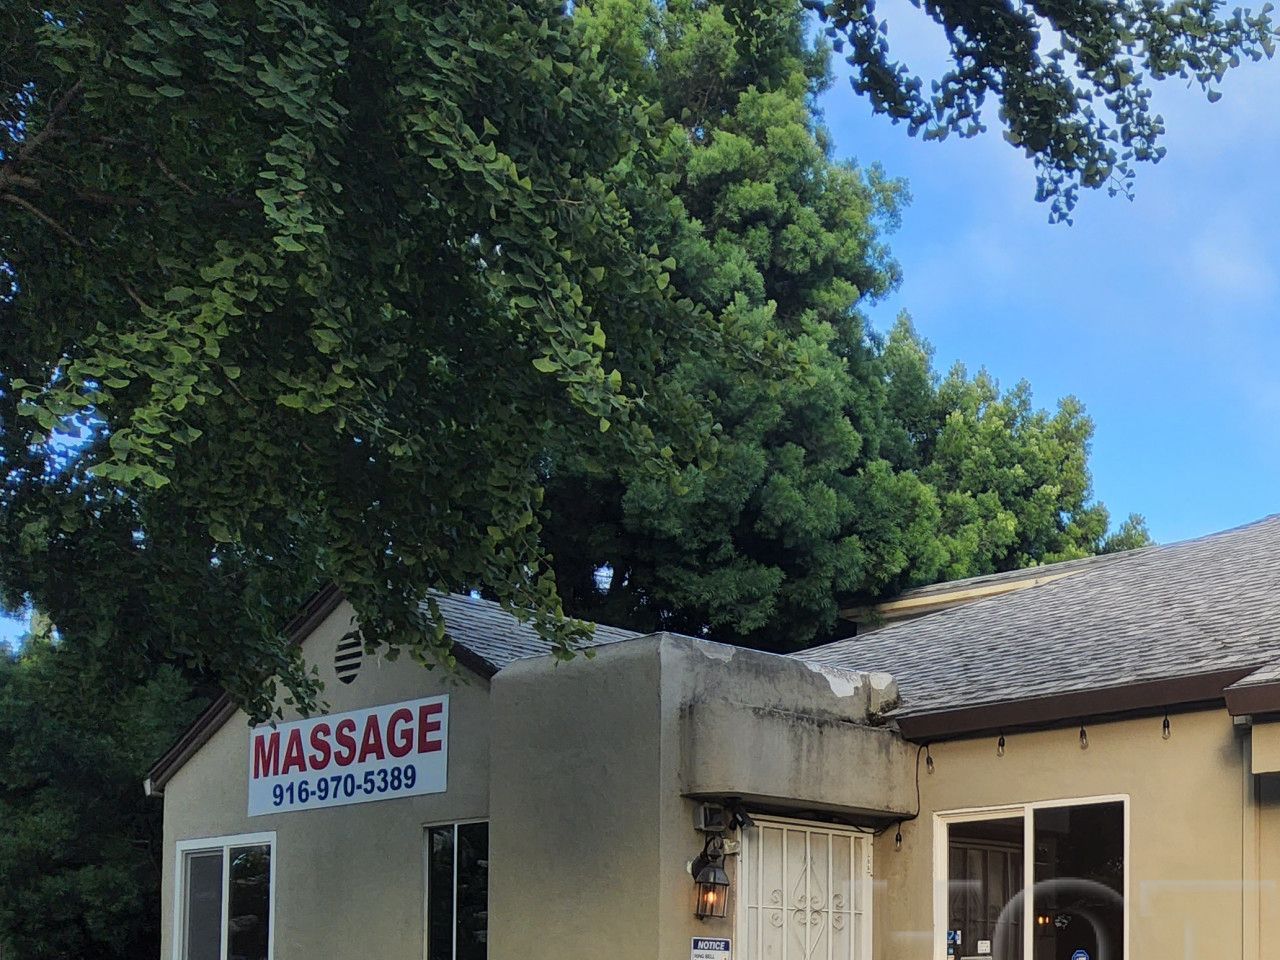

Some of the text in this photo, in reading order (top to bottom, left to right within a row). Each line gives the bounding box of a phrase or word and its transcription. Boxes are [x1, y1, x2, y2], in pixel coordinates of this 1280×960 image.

[253, 702, 443, 779] MASSAGE
[272, 764, 417, 807] 916-970-5389
[698, 941, 725, 950] NOTICE
